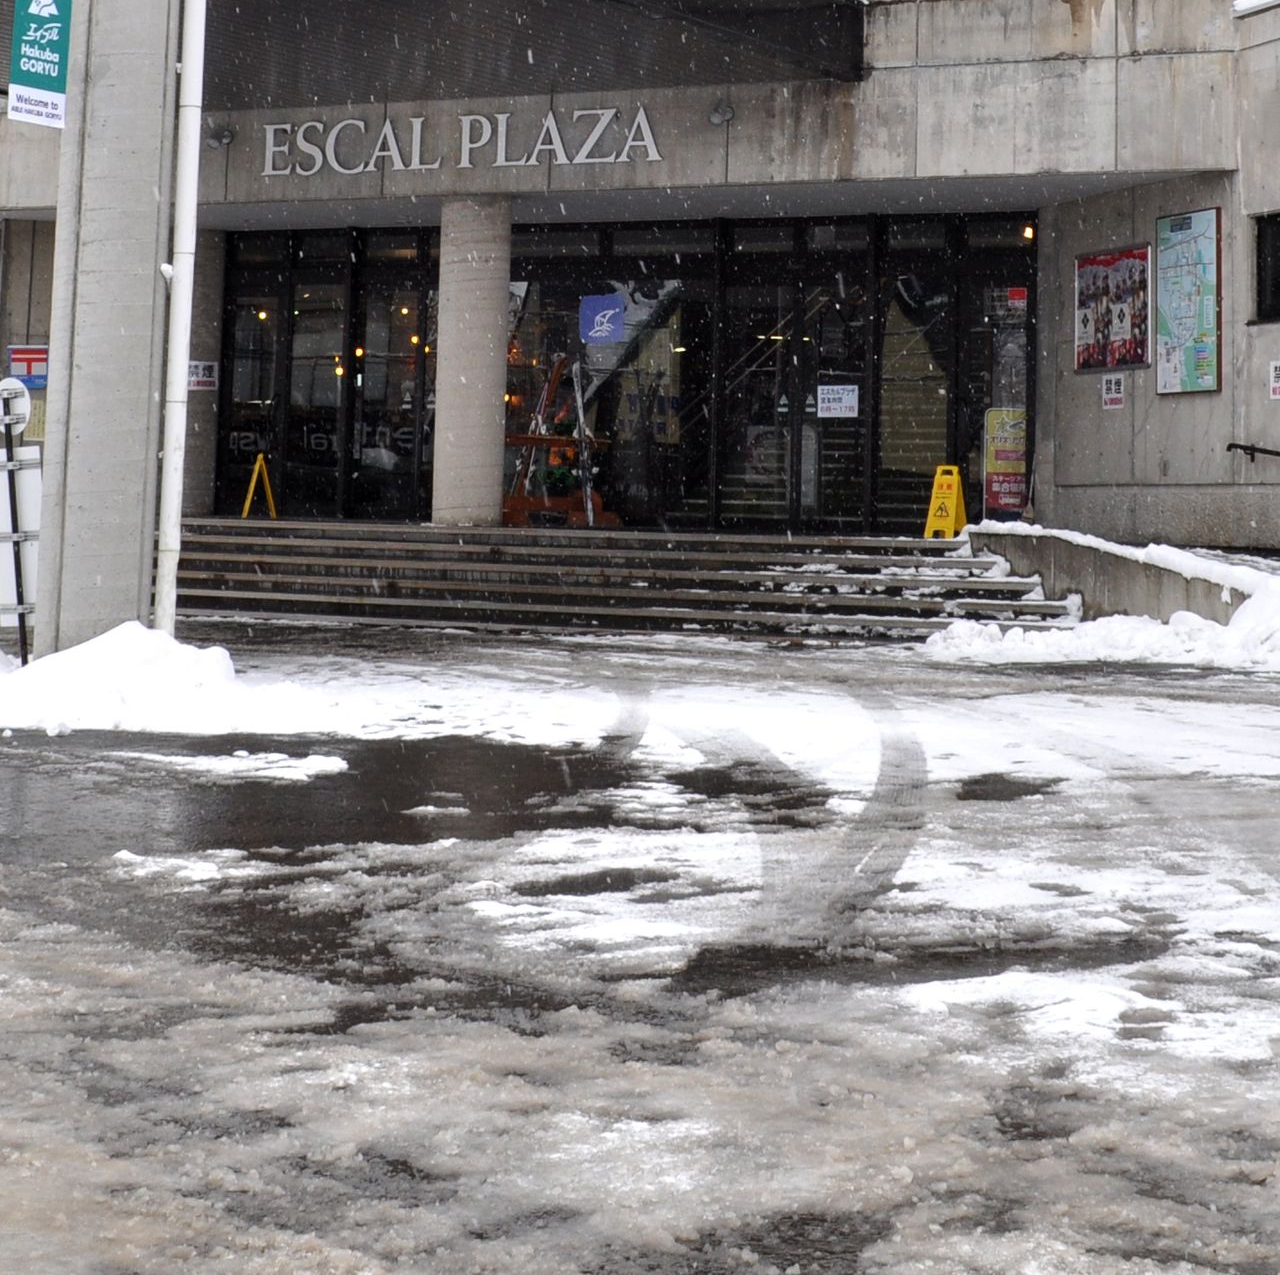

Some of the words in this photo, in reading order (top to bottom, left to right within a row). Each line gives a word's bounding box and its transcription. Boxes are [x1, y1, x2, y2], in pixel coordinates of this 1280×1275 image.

[21, 43, 60, 62] Hakuba
[20, 57, 59, 77] GORYU
[16, 93, 49, 109] Welcome
[50, 100, 59, 110] to
[261, 116, 442, 177] ESCAL
[455, 106, 663, 169] PLAZA
